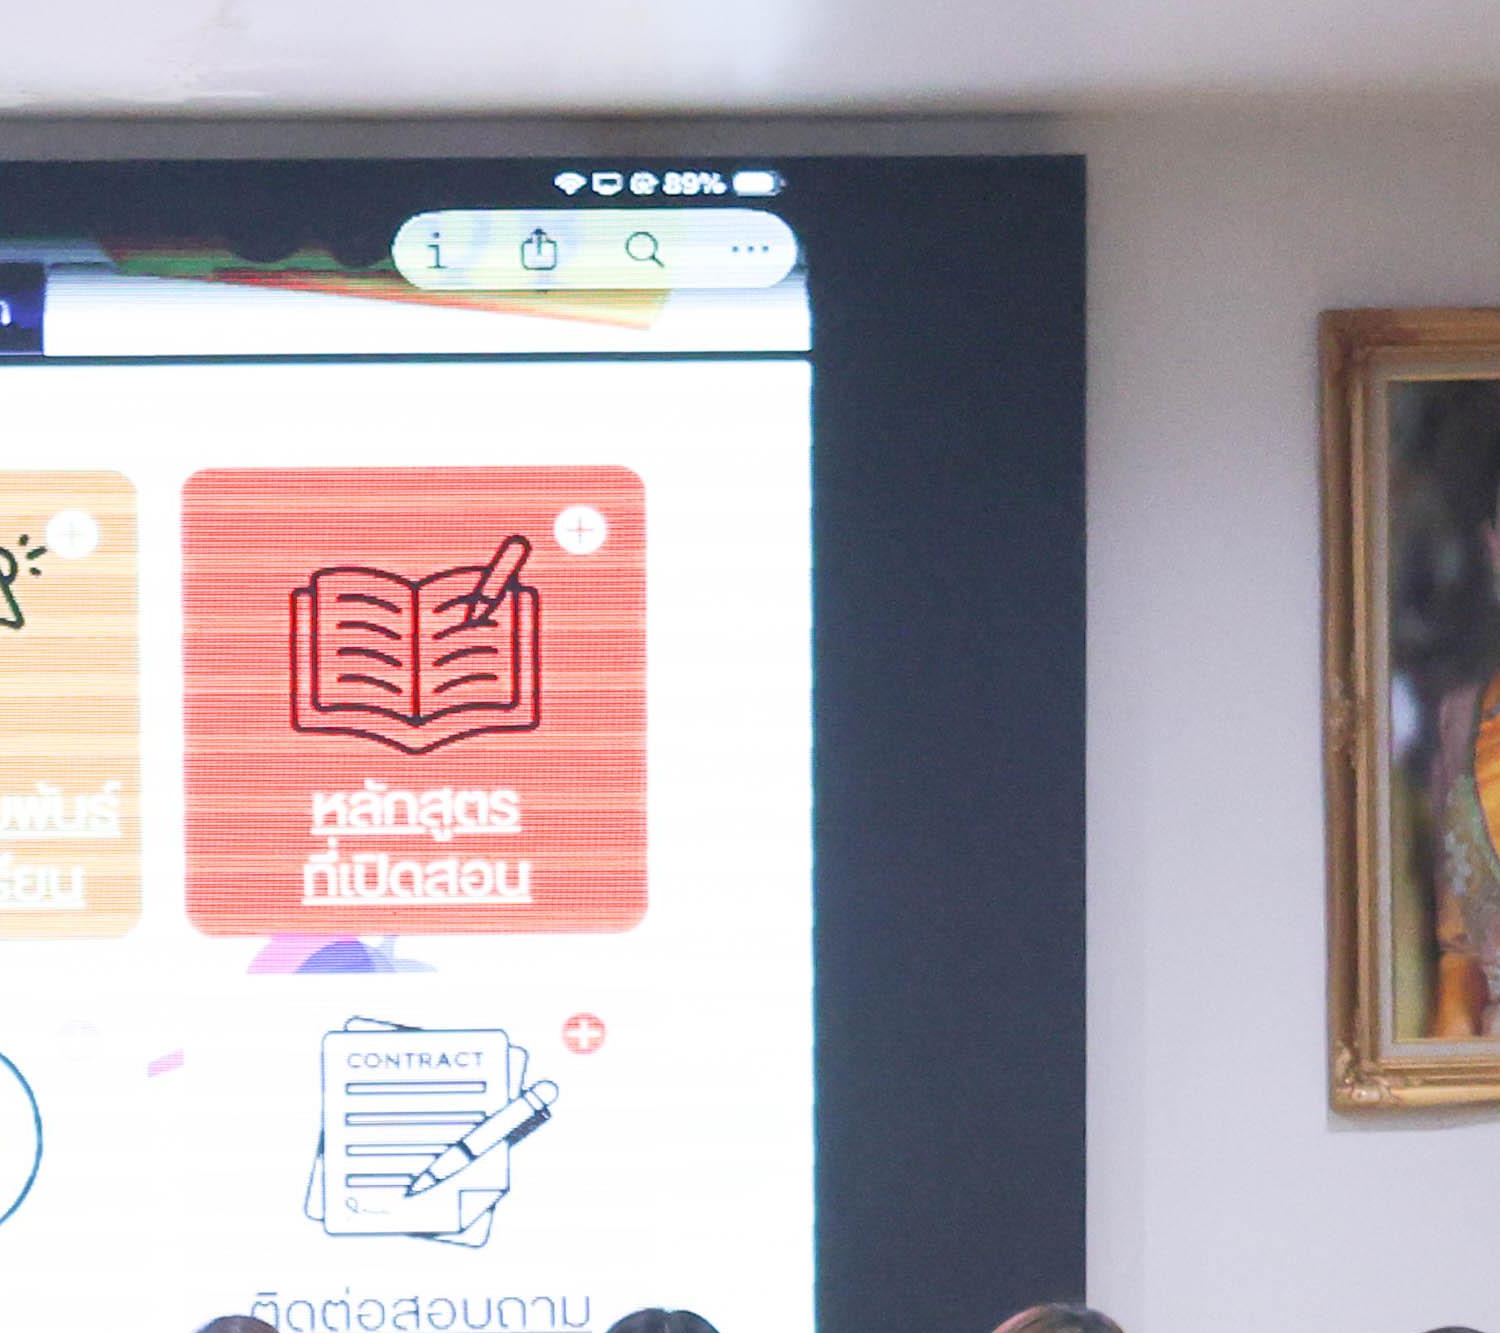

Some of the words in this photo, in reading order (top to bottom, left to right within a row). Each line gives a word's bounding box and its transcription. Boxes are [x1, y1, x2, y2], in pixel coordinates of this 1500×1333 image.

[662, 171, 727, 196] 89%
[311, 779, 522, 842] หลักสูตร
[303, 836, 532, 904] ที่เปิดสอน
[346, 1050, 485, 1070] CONTRACT
[251, 1288, 591, 1333] ติดต่อสอบถาม
